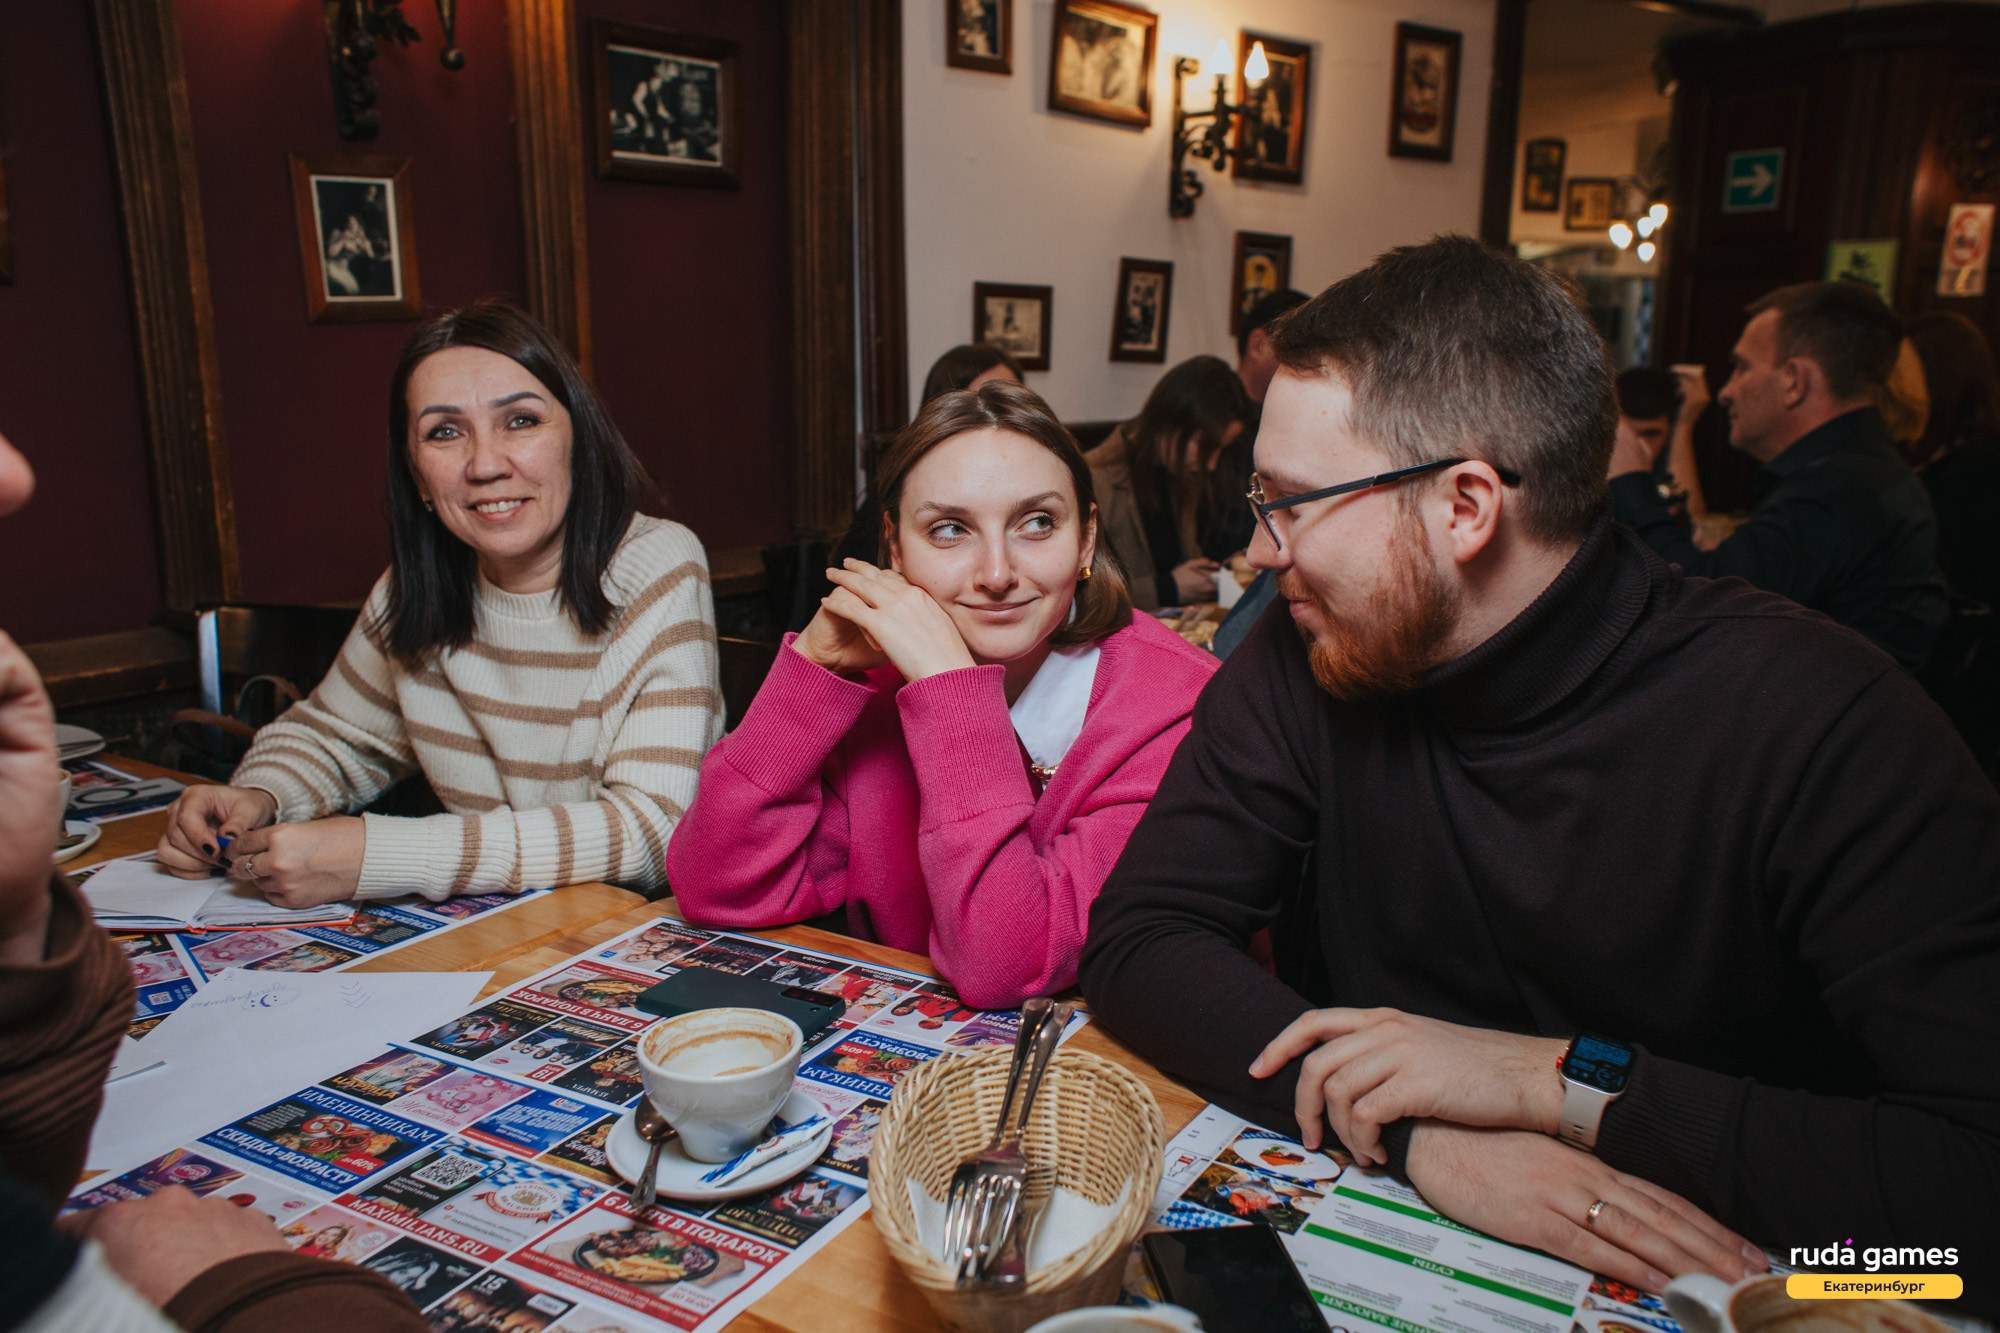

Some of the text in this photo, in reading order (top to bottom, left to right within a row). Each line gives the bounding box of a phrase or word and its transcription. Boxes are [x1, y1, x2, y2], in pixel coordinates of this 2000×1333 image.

[511, 989, 585, 1012] ПОДАРОК
[587, 1010, 634, 1026] ЛАНЧ
[628, 1021, 645, 1029] 6
[837, 1044, 864, 1054] 60%
[847, 1034, 936, 1062] =ВОЗРАСТУ
[529, 1068, 555, 1080] 19
[800, 1065, 896, 1098] ННИКАМ
[329, 1075, 400, 1100] ЦАРИЦА
[569, 1083, 601, 1095] МАРТА
[294, 1089, 439, 1142] ИМЕНИННИКАМ
[506, 1104, 590, 1125] ВЕЧЕРИНКА
[524, 1117, 578, 1133] СВОИХ
[211, 1127, 360, 1186] СКИДКА=ВОЗРАСТУ
[348, 1157, 379, 1170] 60%
[345, 1198, 489, 1256] MAXIMILIANS.RU
[600, 1194, 623, 1207] 6
[613, 1199, 674, 1225] ЛНЧ
[666, 1217, 690, 1231] В
[679, 1223, 782, 1265] ПОДАРОК
[1410, 1257, 1456, 1276] СУПЫ
[473, 1272, 510, 1292] 15
[1319, 1294, 1391, 1324] ЗАКУСКИ
